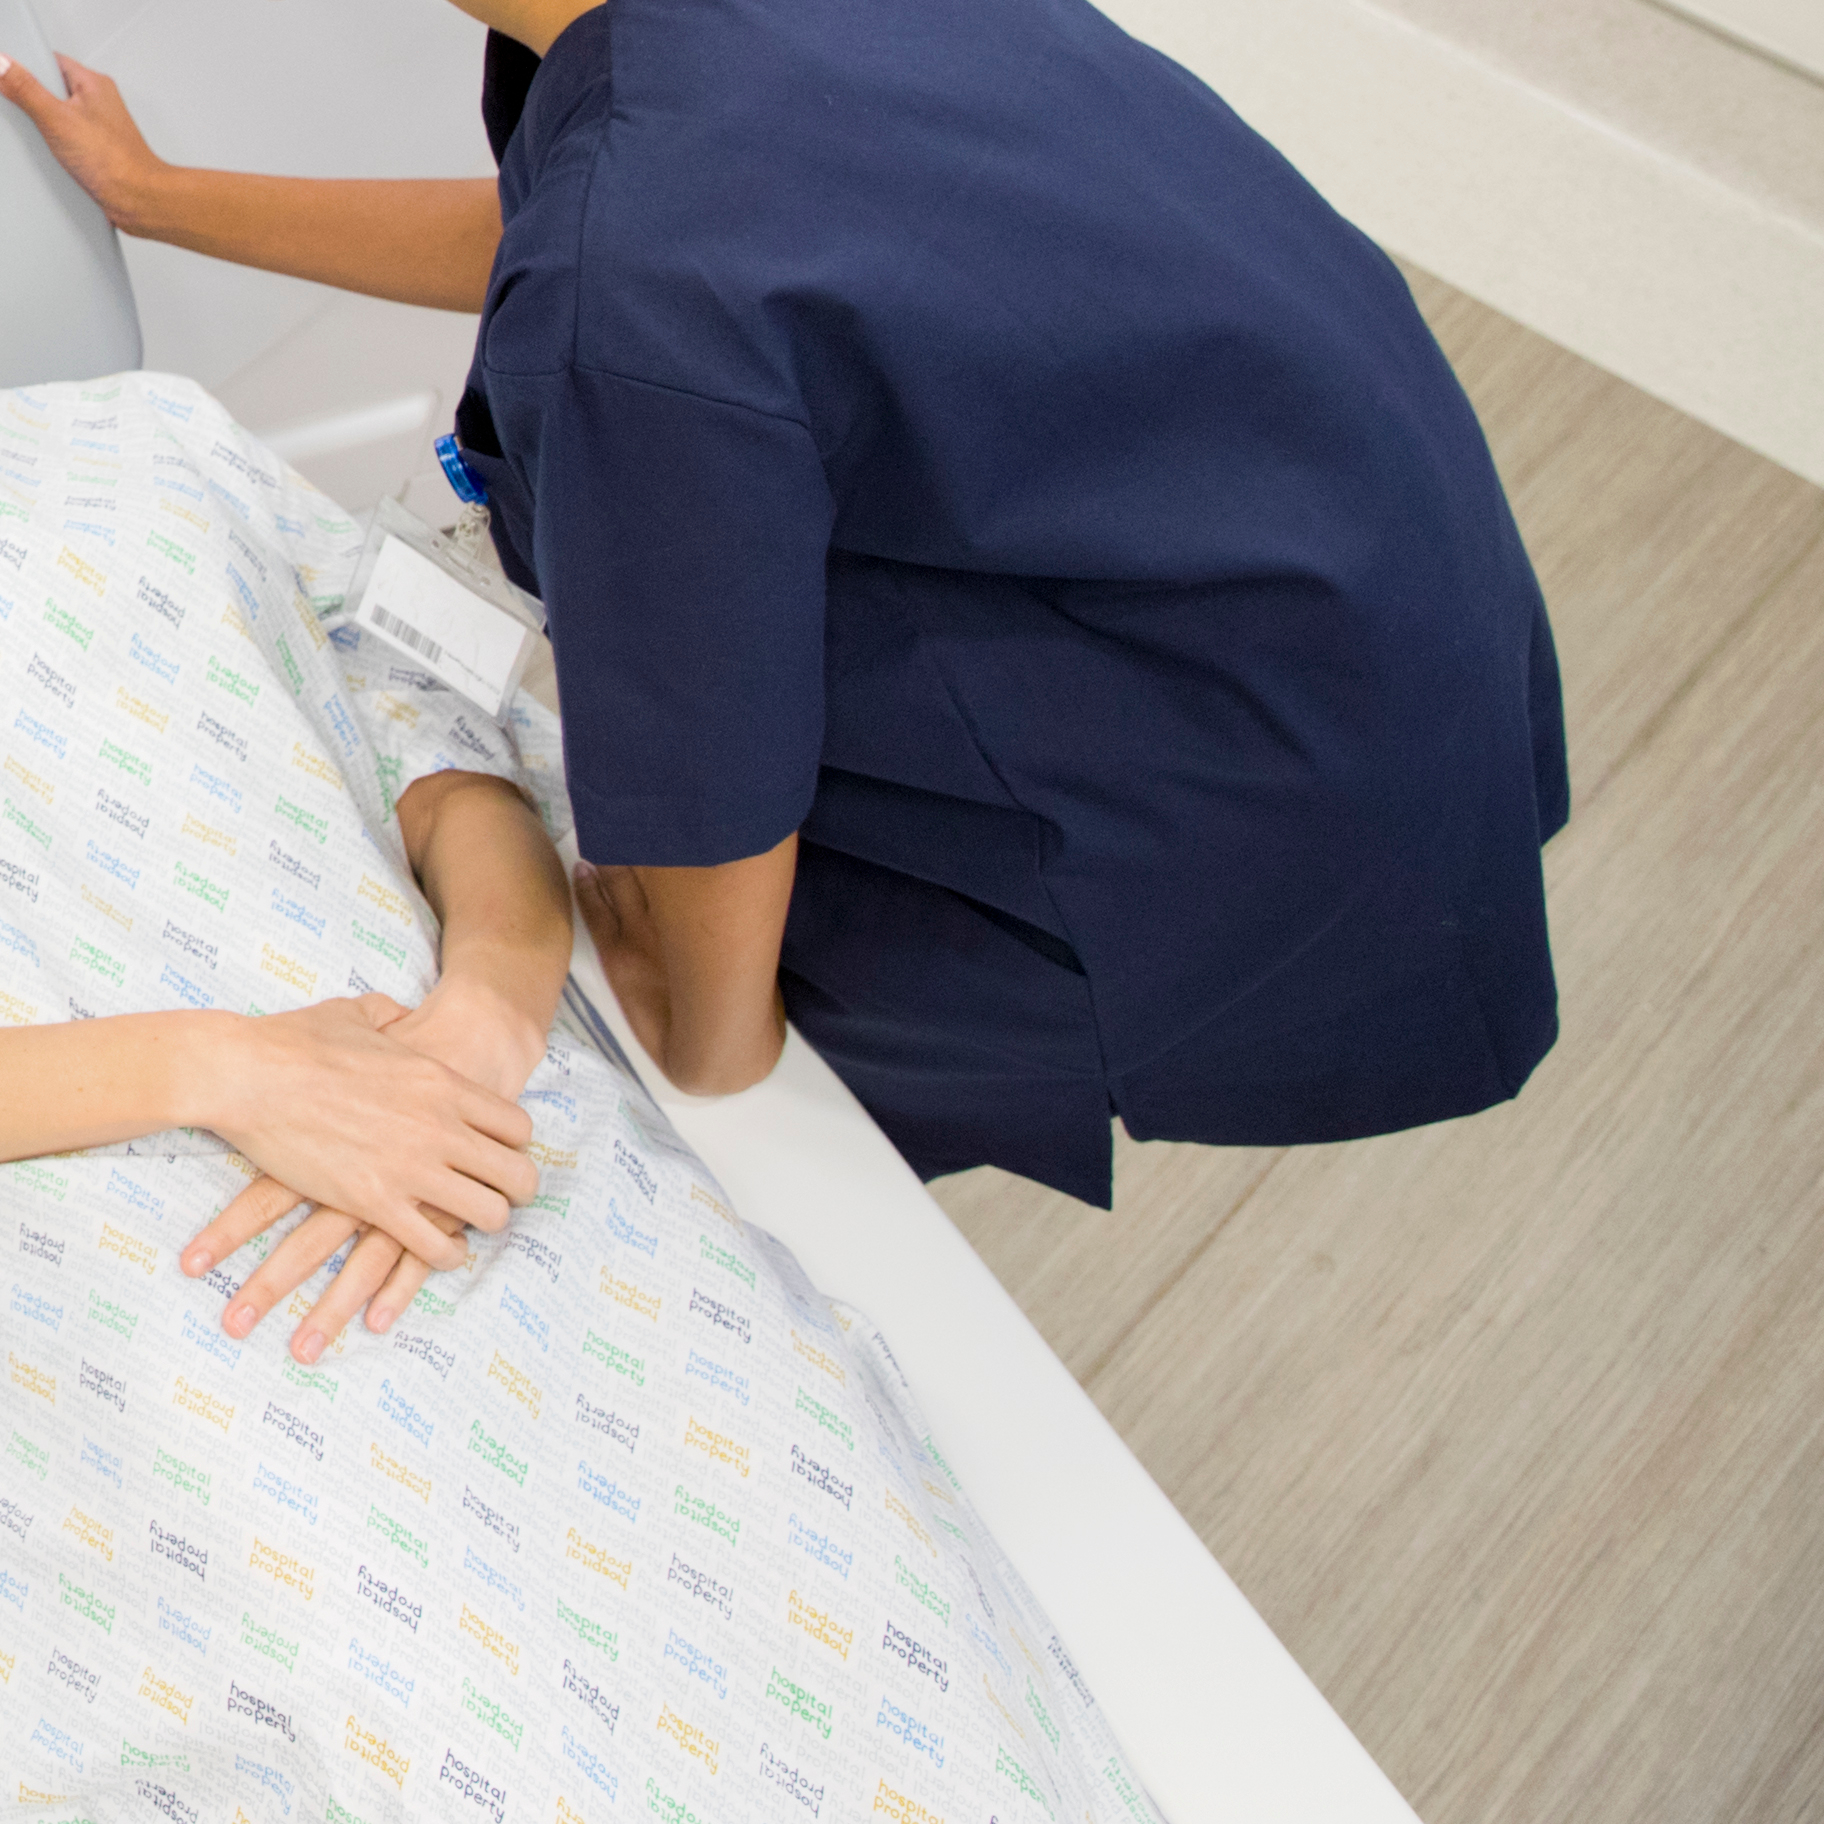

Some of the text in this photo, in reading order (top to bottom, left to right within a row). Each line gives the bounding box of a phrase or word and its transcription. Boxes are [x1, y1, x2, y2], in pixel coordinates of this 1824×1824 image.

[27, 663, 74, 708] property
[33, 652, 76, 694] hospital
[206, 672, 254, 707] hospital
[208, 656, 260, 696] property
[197, 720, 247, 762] property
[201, 712, 247, 747] hospital
[99, 748, 152, 786] property
[103, 739, 152, 773] hospital
[275, 804, 327, 844] property
[278, 795, 328, 829] hospital
[87, 840, 141, 880] property
[87, 852, 137, 890] hospital
[272, 889, 326, 928] property
[357, 884, 411, 925] property
[362, 874, 410, 911] hospital
[166, 920, 218, 955] hospital
[271, 903, 322, 938] hospital
[70, 948, 124, 987] property
[75, 936, 126, 973] hospital
[162, 929, 217, 970] property
[262, 943, 317, 984] property
[261, 959, 314, 997] hospital
[106, 1181, 163, 1221] property
[111, 1168, 165, 1208] hospital
[20, 1223, 65, 1254] property
[20, 1241, 61, 1266] hospital
[98, 1235, 156, 1275] property
[103, 1222, 158, 1258] hospital
[600, 1266, 662, 1310] property
[600, 1282, 658, 1322] hospital
[692, 1288, 750, 1328] hospital
[689, 1300, 751, 1344] property
[393, 1341, 449, 1379] hospital
[395, 1331, 455, 1367] property
[582, 1341, 645, 1387] property
[587, 1330, 645, 1371] hospital
[9, 1352, 56, 1391] property
[11, 1372, 55, 1405] hospital
[80, 1373, 125, 1413] property
[81, 1359, 126, 1391] hospital
[487, 1363, 540, 1420] property
[494, 1350, 542, 1401] hospital
[172, 1393, 230, 1433] hospital
[174, 1376, 235, 1419] property
[381, 1379, 434, 1436] property
[576, 1393, 640, 1438] property
[262, 1410, 324, 1461] property
[267, 1401, 324, 1446] hospital
[377, 1398, 429, 1448] hospital
[575, 1411, 635, 1453] hospital
[689, 1417, 749, 1459] hospital
[157, 1448, 211, 1486] hospital
[370, 1442, 432, 1493] property
[468, 1438, 525, 1487] hospital
[471, 1420, 529, 1476] property
[684, 1431, 750, 1478] property
[153, 1461, 211, 1506] property
[371, 1457, 430, 1504] hospital
[578, 1461, 641, 1510] property
[790, 1444, 853, 1497] property
[791, 1461, 850, 1510] hospital
[465, 1485, 520, 1535] hospital
[578, 1478, 636, 1523] hospital
[675, 1485, 741, 1533] property
[62, 1518, 114, 1562] property
[71, 1507, 113, 1542] hospital
[149, 1520, 208, 1565] property
[367, 1516, 429, 1569] property
[371, 1505, 428, 1552] hospital
[462, 1496, 520, 1553] property
[674, 1503, 737, 1547] hospital
[151, 1539, 205, 1581] hospital
[253, 1537, 315, 1581] hospital
[566, 1546, 628, 1590] hospital
[567, 1527, 632, 1576] property
[59, 1573, 116, 1621] property
[249, 1552, 314, 1601] property
[357, 1564, 422, 1619] property
[667, 1567, 732, 1620] property
[672, 1553, 733, 1601] hospital
[61, 1593, 112, 1635] hospital
[357, 1582, 418, 1633] hospital
[788, 1590, 854, 1645] property
[459, 1616, 519, 1676] property
[462, 1603, 520, 1657] hospital
[788, 1610, 849, 1660] hospital
[886, 1620, 947, 1672] hospital
[47, 1661, 95, 1703] property
[53, 1648, 100, 1685] hospital
[882, 1634, 949, 1692] property
[138, 1685, 188, 1725] hospital
[143, 1666, 194, 1709] property
[230, 1681, 292, 1727] hospital
[562, 1676, 614, 1733] hospital
[563, 1659, 620, 1721] property
[772, 1668, 833, 1719] hospital
[227, 1697, 296, 1743] property
[662, 1704, 719, 1755] hospital
[766, 1684, 832, 1740] property
[882, 1696, 944, 1747] hospital
[346, 1715, 410, 1774] property
[657, 1715, 718, 1775] property
[876, 1711, 944, 1769] property
[345, 1736, 404, 1789] hospital
[445, 1748, 506, 1804] hospital
[759, 1742, 824, 1801] property
[439, 1764, 504, 1824] property
[760, 1763, 820, 1818] hospital
